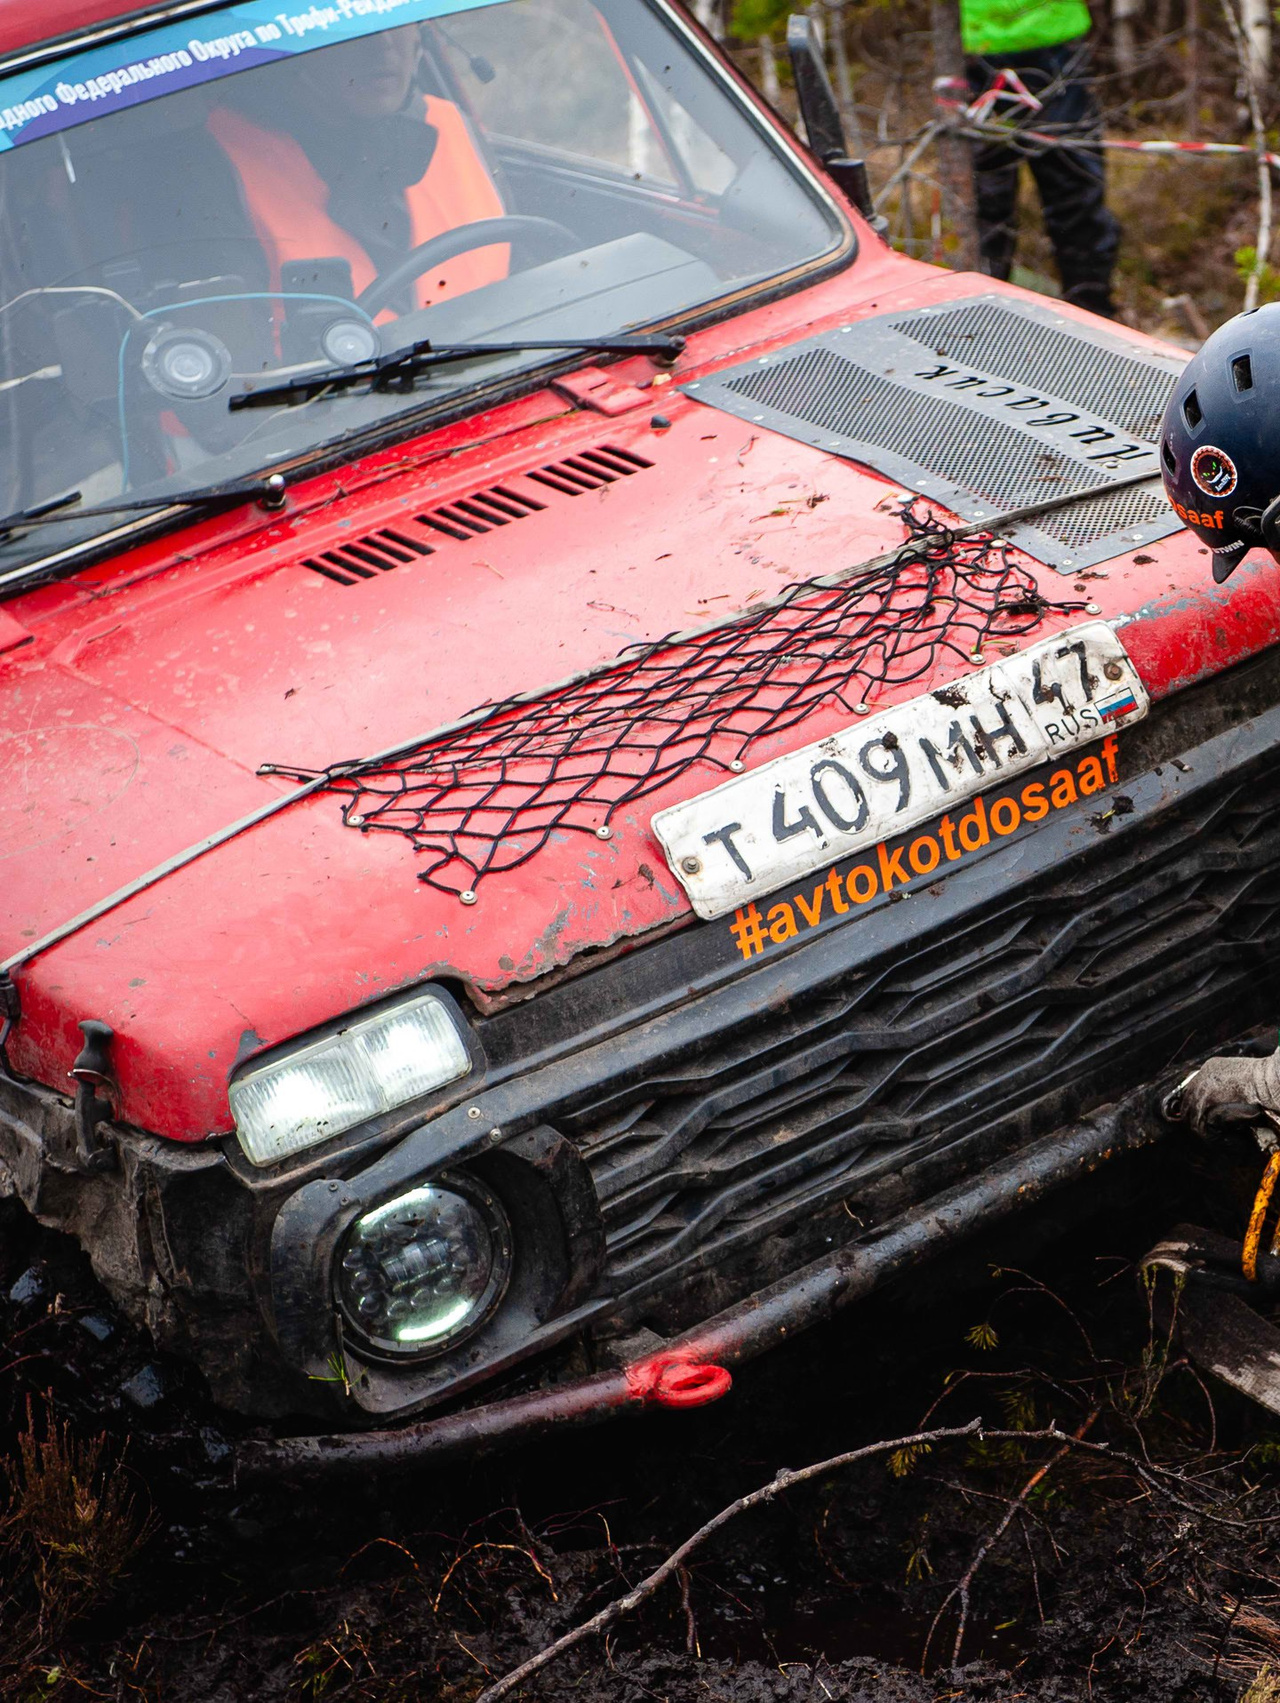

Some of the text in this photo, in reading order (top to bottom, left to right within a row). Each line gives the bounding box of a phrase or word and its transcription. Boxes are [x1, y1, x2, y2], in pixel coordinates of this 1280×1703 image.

[55, 50, 192, 105] Федерального
[188, 30, 258, 62] Округа
[254, 22, 282, 43] по
[1045, 709, 1099, 745] RUS
[730, 734, 1121, 960] #avtokotdosaaf
